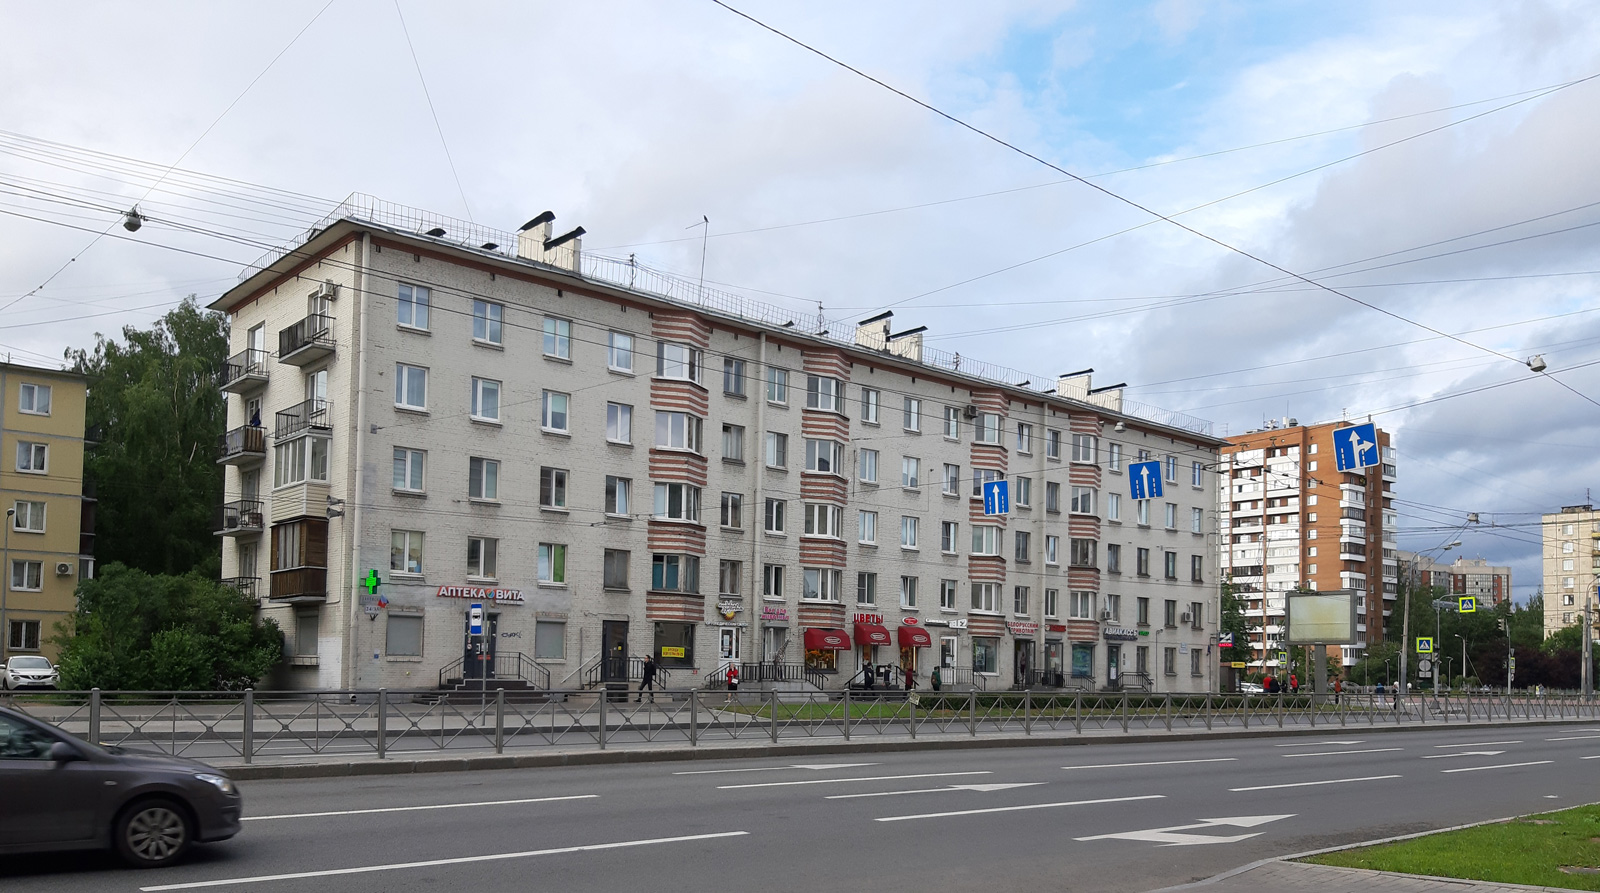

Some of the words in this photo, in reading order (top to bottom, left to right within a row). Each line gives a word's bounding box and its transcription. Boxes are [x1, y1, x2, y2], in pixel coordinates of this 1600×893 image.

[438, 586, 486, 598] АПТЕКА
[495, 589, 525, 600] ВИТА
[853, 612, 884, 624] ЦВЕТЫ
[1007, 621, 1039, 629] БЕЛОРУССКИЙ
